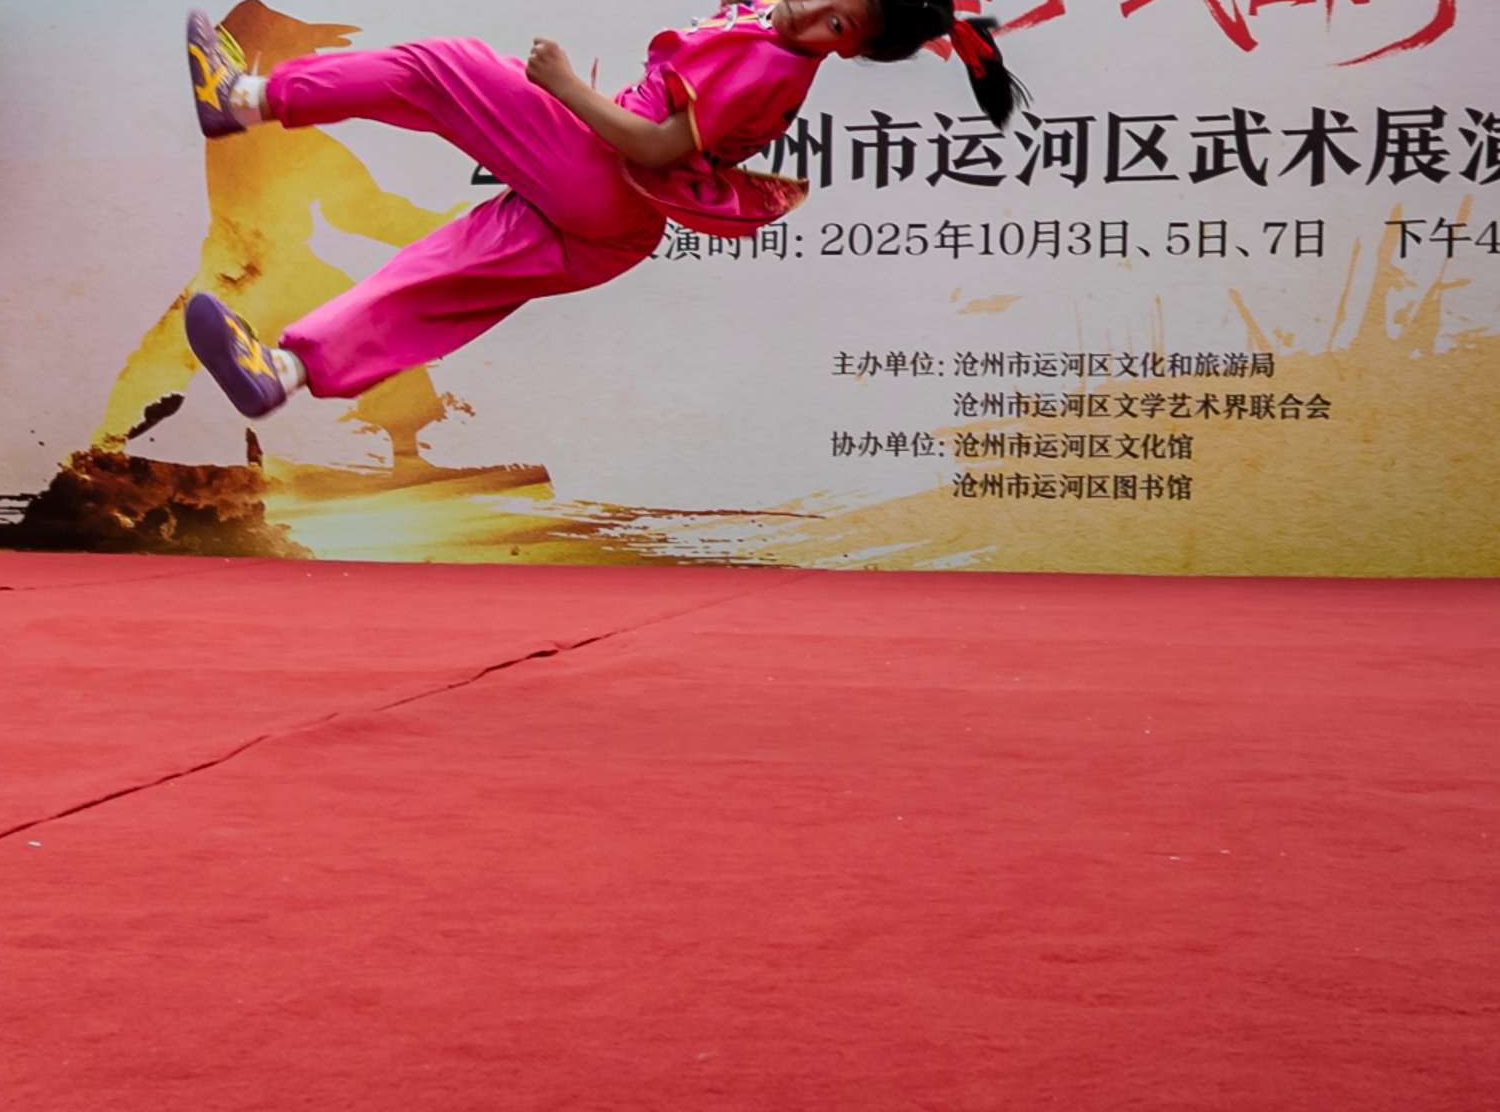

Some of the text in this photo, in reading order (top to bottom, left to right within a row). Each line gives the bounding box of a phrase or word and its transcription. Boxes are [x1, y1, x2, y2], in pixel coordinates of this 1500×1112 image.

[742, 105, 1500, 190] 州市运河区武术展演
[1384, 216, 1500, 260] 下午4
[952, 391, 1333, 420] 沧州市运河区文学艺术界联合会
[951, 472, 1194, 501] 沧州市运河区图书馆
